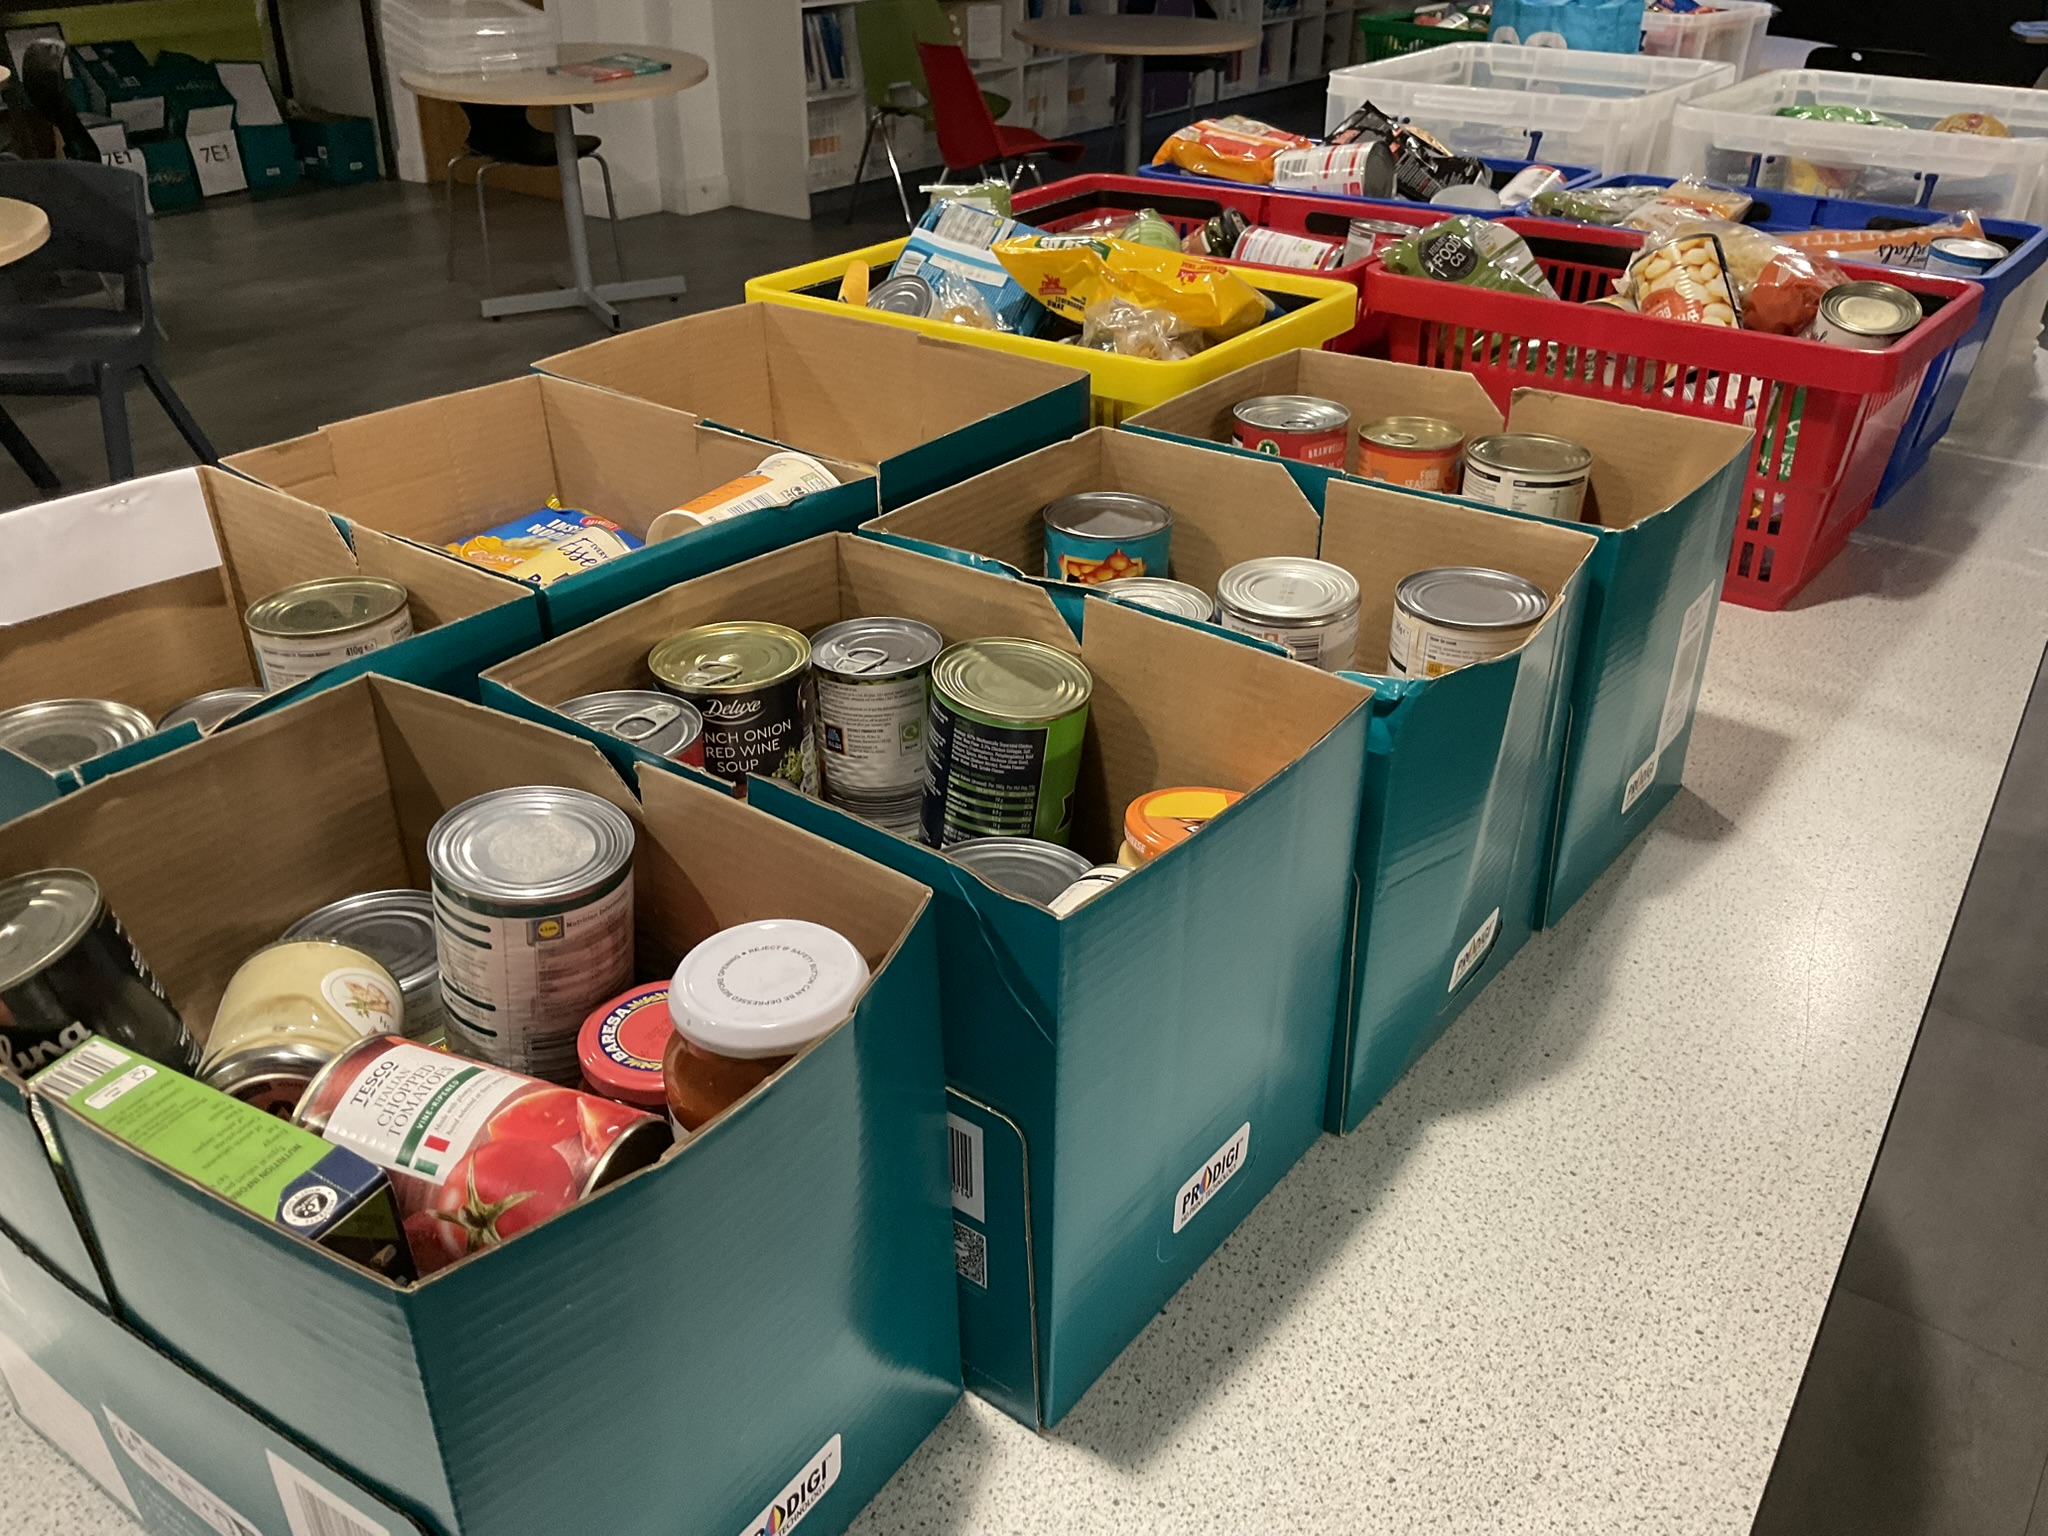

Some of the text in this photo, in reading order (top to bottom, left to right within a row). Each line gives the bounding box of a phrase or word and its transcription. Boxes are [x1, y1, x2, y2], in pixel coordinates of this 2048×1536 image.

[103, 150, 133, 166] 7E1
[200, 144, 231, 163] 7E1
[702, 699, 761, 719] Deluxe
[703, 718, 792, 744] NCH ONION
[705, 738, 781, 759] RED WINE
[717, 759, 759, 773] SOUP
[748, 945, 782, 954] REJECT
[790, 947, 814, 964] SAFETY
[602, 1007, 631, 1062] BARESA
[351, 1061, 395, 1105] TESCO
[374, 1068, 412, 1108] ITALIAN
[377, 1064, 435, 1127] CHOPPED
[387, 1065, 455, 1137] TOMATOES
[416, 1079, 460, 1130] VINE-RIPENED
